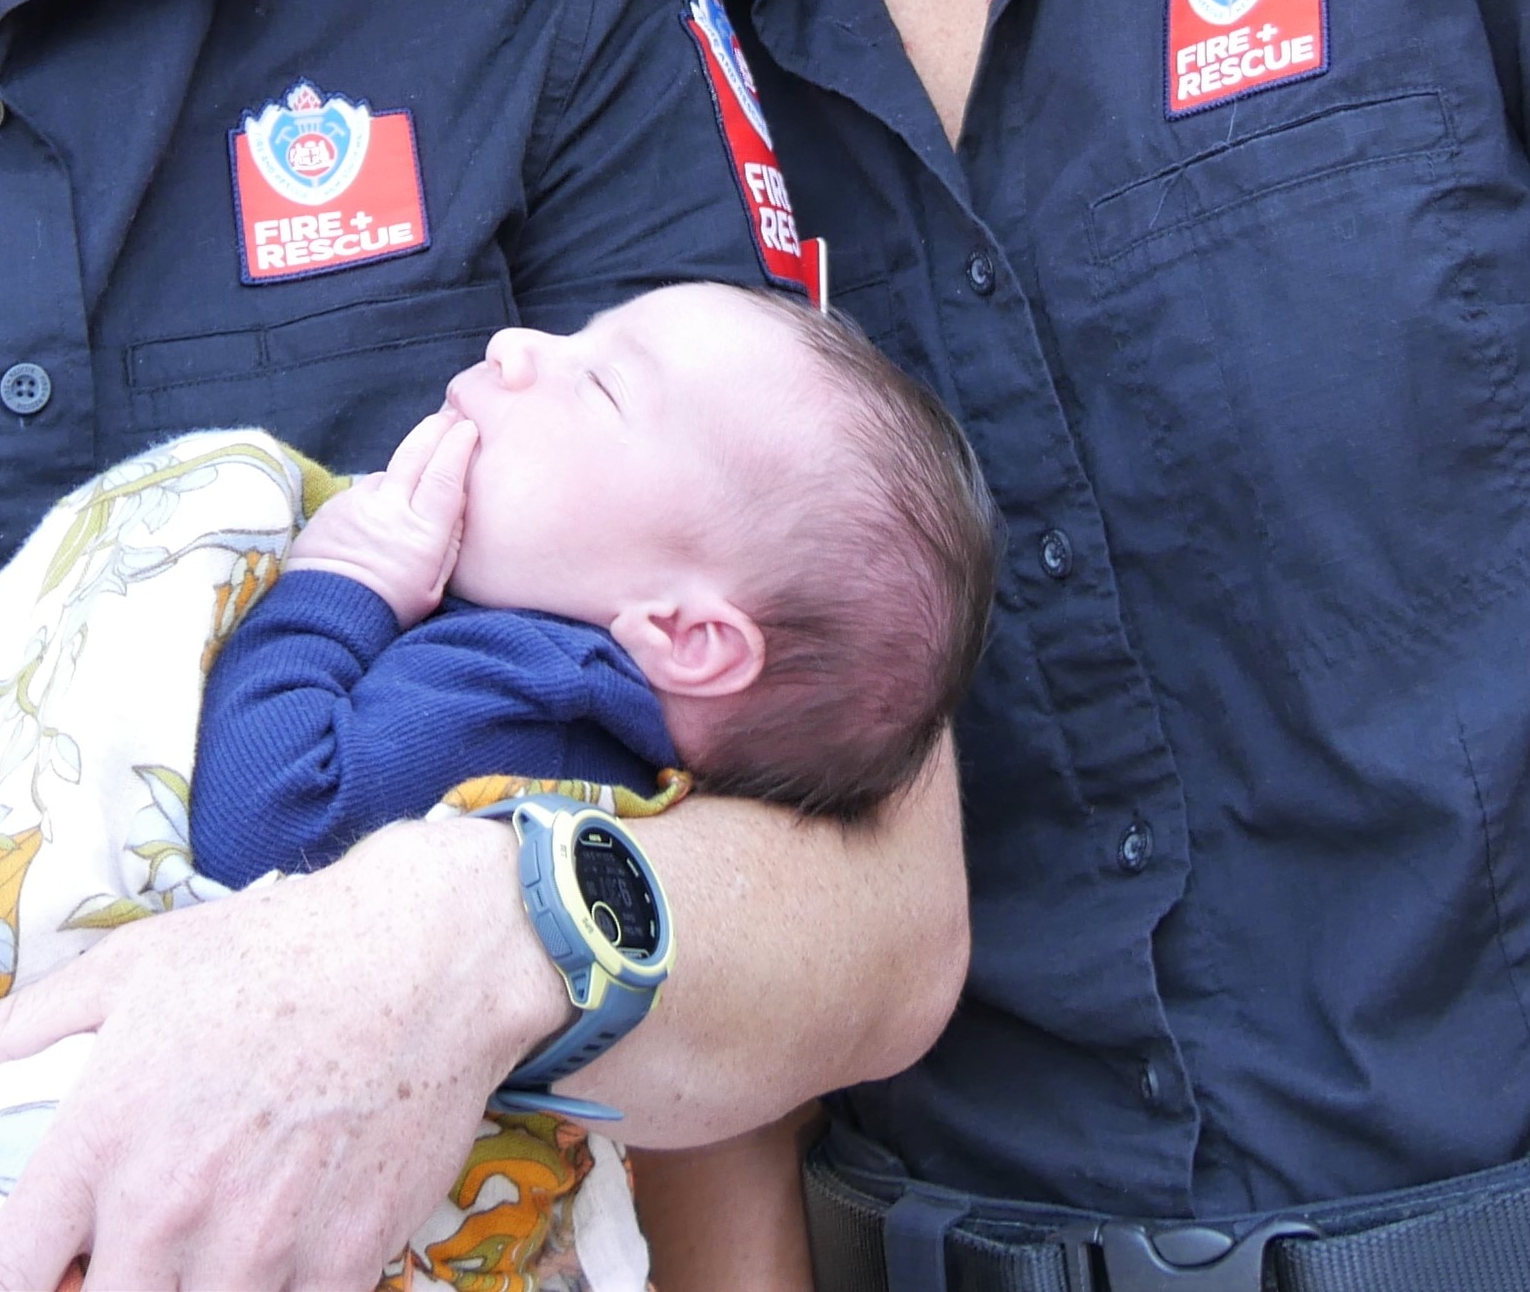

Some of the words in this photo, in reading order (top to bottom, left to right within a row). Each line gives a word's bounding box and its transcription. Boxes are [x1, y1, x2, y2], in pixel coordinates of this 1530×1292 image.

[1177, 26, 1251, 75] FIRE
[1177, 34, 1315, 100] RESCUE
[744, 161, 792, 213] FIR
[254, 211, 344, 246] FIRE
[256, 222, 414, 270] RESCUE
